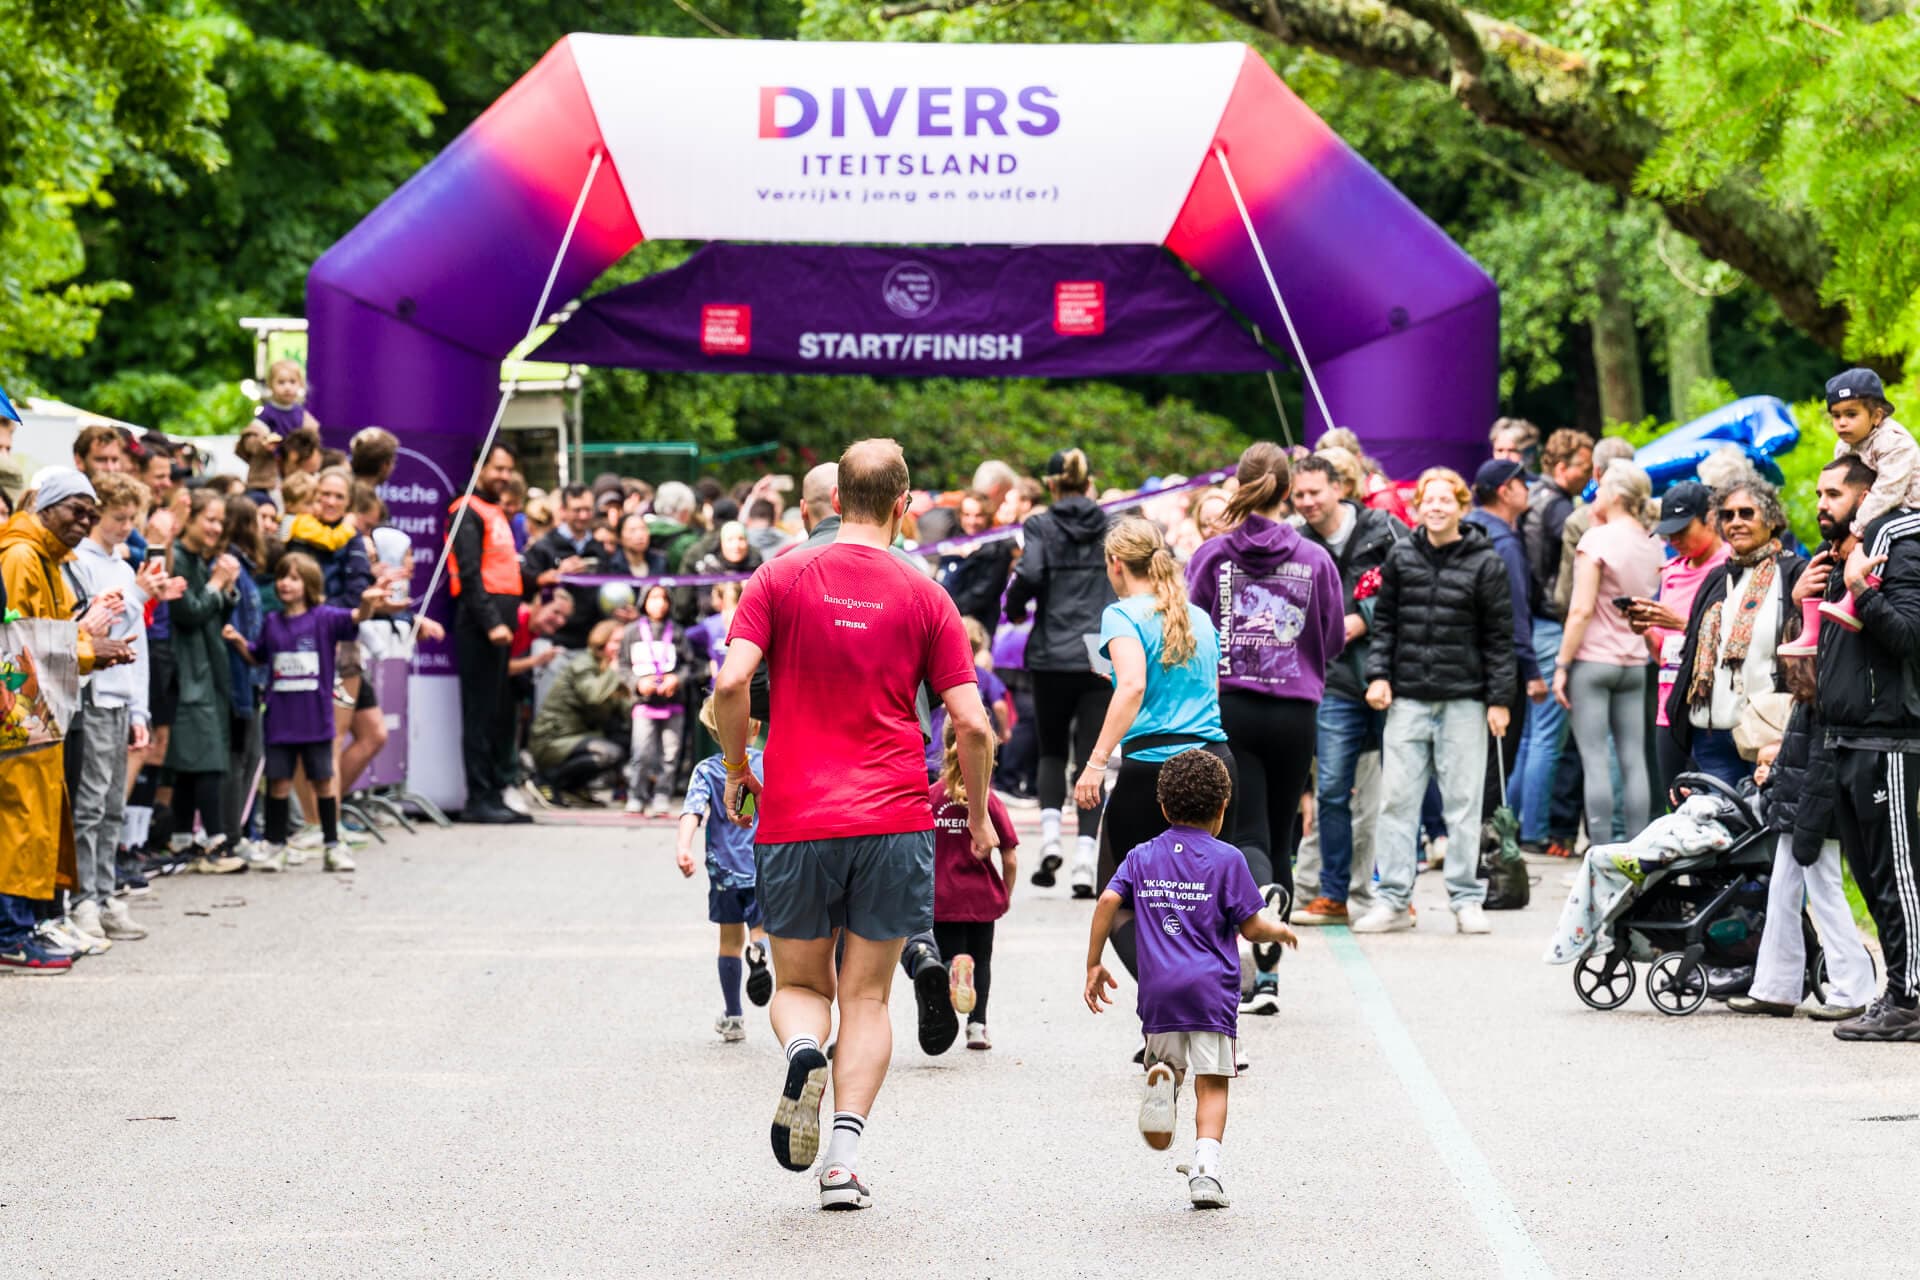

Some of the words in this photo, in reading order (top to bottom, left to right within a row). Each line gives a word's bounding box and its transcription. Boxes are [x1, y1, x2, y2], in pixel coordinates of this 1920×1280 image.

[758, 86, 1060, 139] DIVERS
[802, 154, 1017, 175] ITEITSLAND
[757, 188, 851, 203] Verrijkt
[862, 188, 917, 203] jong
[929, 190, 956, 200] en
[968, 187, 1059, 202] oud(er)
[799, 333, 1023, 360] START/FINISH
[935, 818, 969, 828] NKEN
[1174, 843, 1183, 853] D
[1156, 879, 1177, 889] LOOP
[1178, 882, 1191, 890] OM
[1192, 882, 1205, 891] ME
